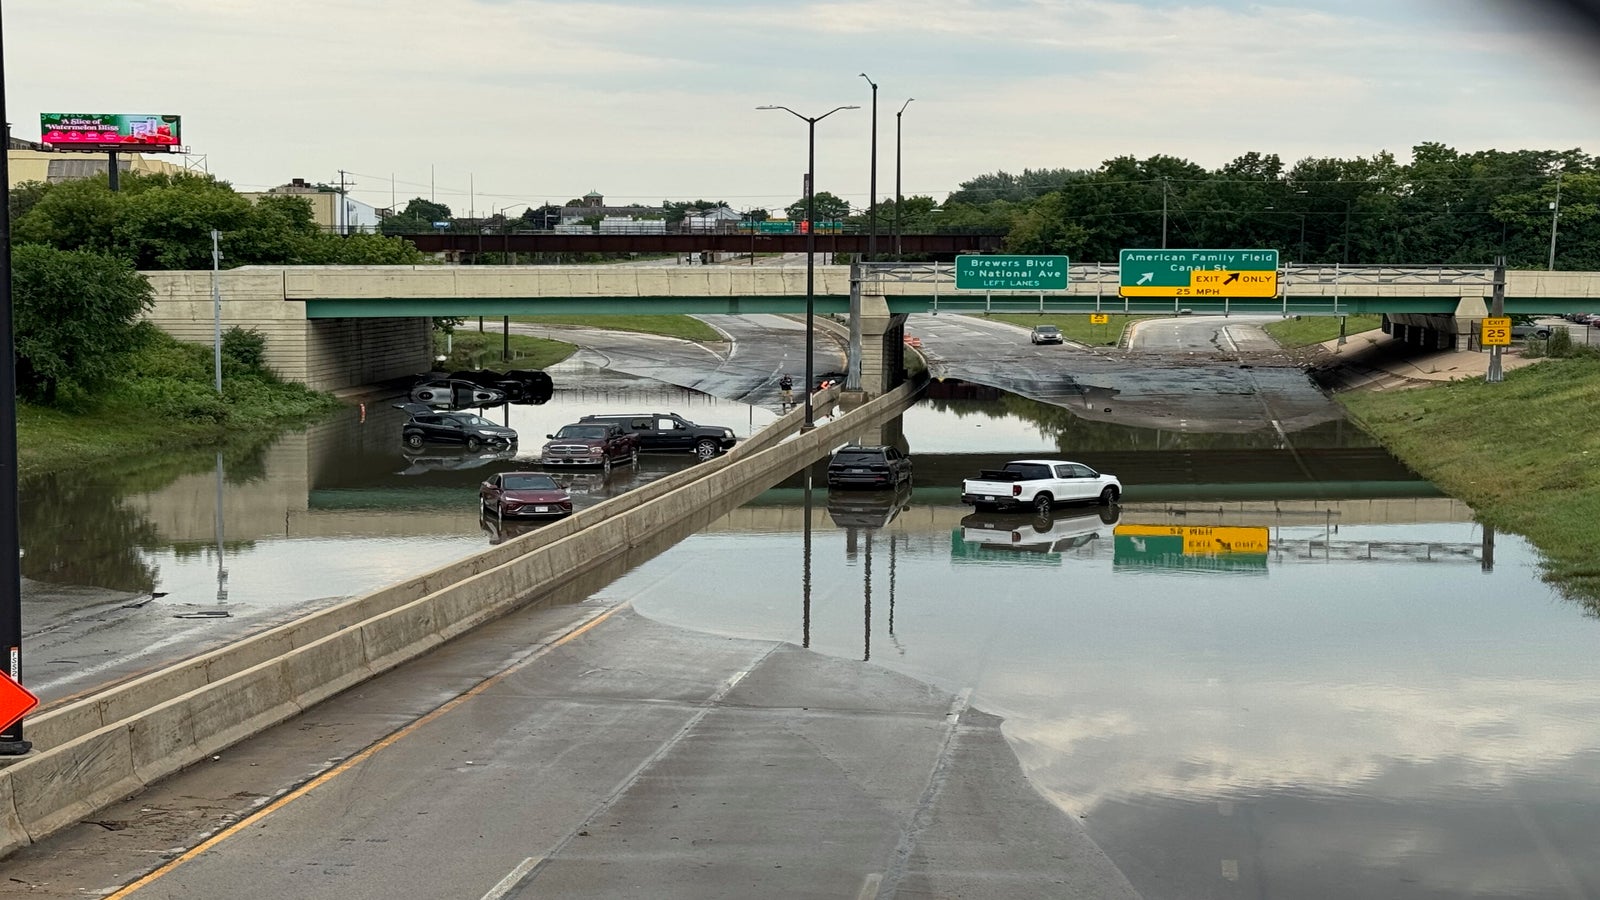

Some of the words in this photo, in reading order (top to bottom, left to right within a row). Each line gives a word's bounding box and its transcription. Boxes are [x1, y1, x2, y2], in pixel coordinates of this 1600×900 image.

[1126, 253, 1186, 261] American
[1192, 253, 1235, 263] Family
[1242, 253, 1273, 261] Field
[971, 259, 1020, 267] Brewers
[1026, 259, 1053, 267] Blvd
[979, 270, 1032, 278] National
[1038, 270, 1061, 278] Ave
[1196, 275, 1221, 283] EXIT
[1242, 275, 1272, 283] ONLY
[1487, 330, 1505, 338] 25
